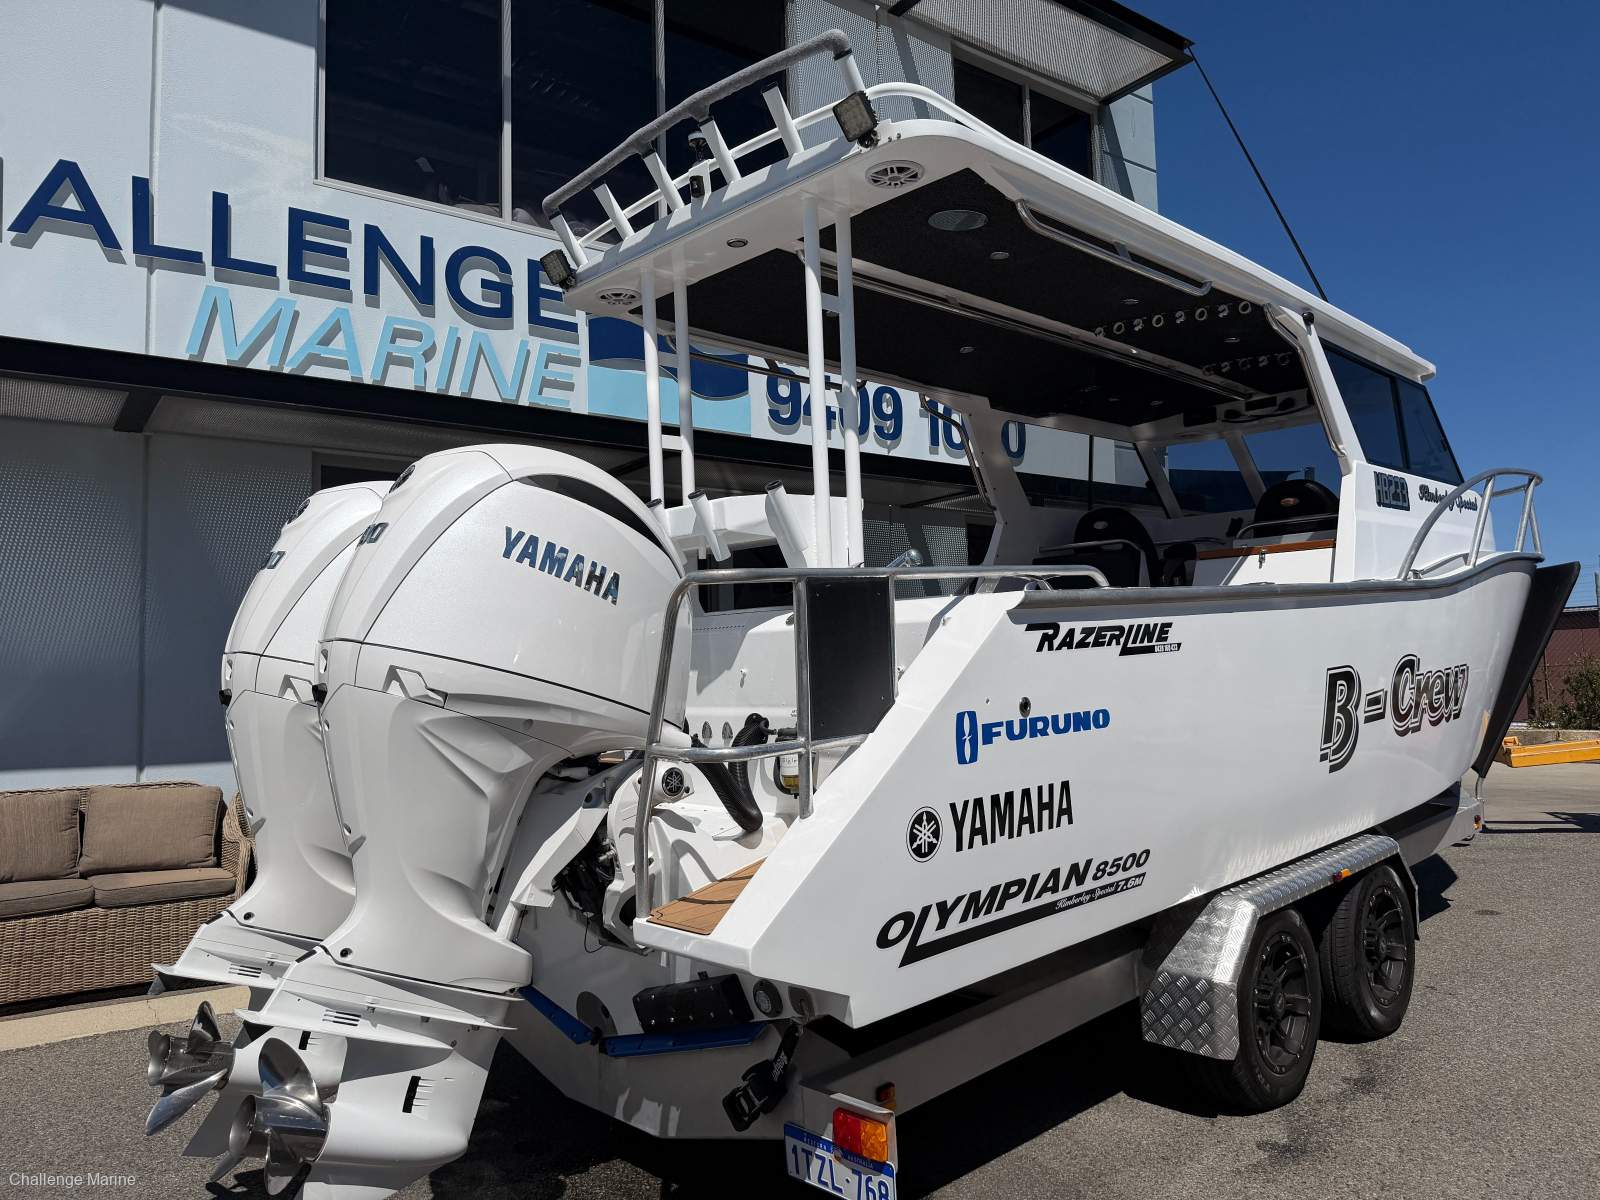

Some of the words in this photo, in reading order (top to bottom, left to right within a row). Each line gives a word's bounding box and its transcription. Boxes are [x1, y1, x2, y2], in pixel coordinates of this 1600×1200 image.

[0, 158, 579, 334] ALLENGE
[187, 285, 582, 407] MARINE
[919, 399, 1026, 459] 100
[502, 525, 621, 605] YAMAHA
[1024, 622, 1174, 656] RAZERLINE
[981, 708, 1111, 746] FURUNO
[949, 779, 1074, 853] YAMAHA
[875, 858, 1094, 968] OLYMPIAN
[1091, 848, 1151, 881] 8500
[1055, 892, 1091, 910] Kimberley
[1092, 882, 1118, 900] Special
